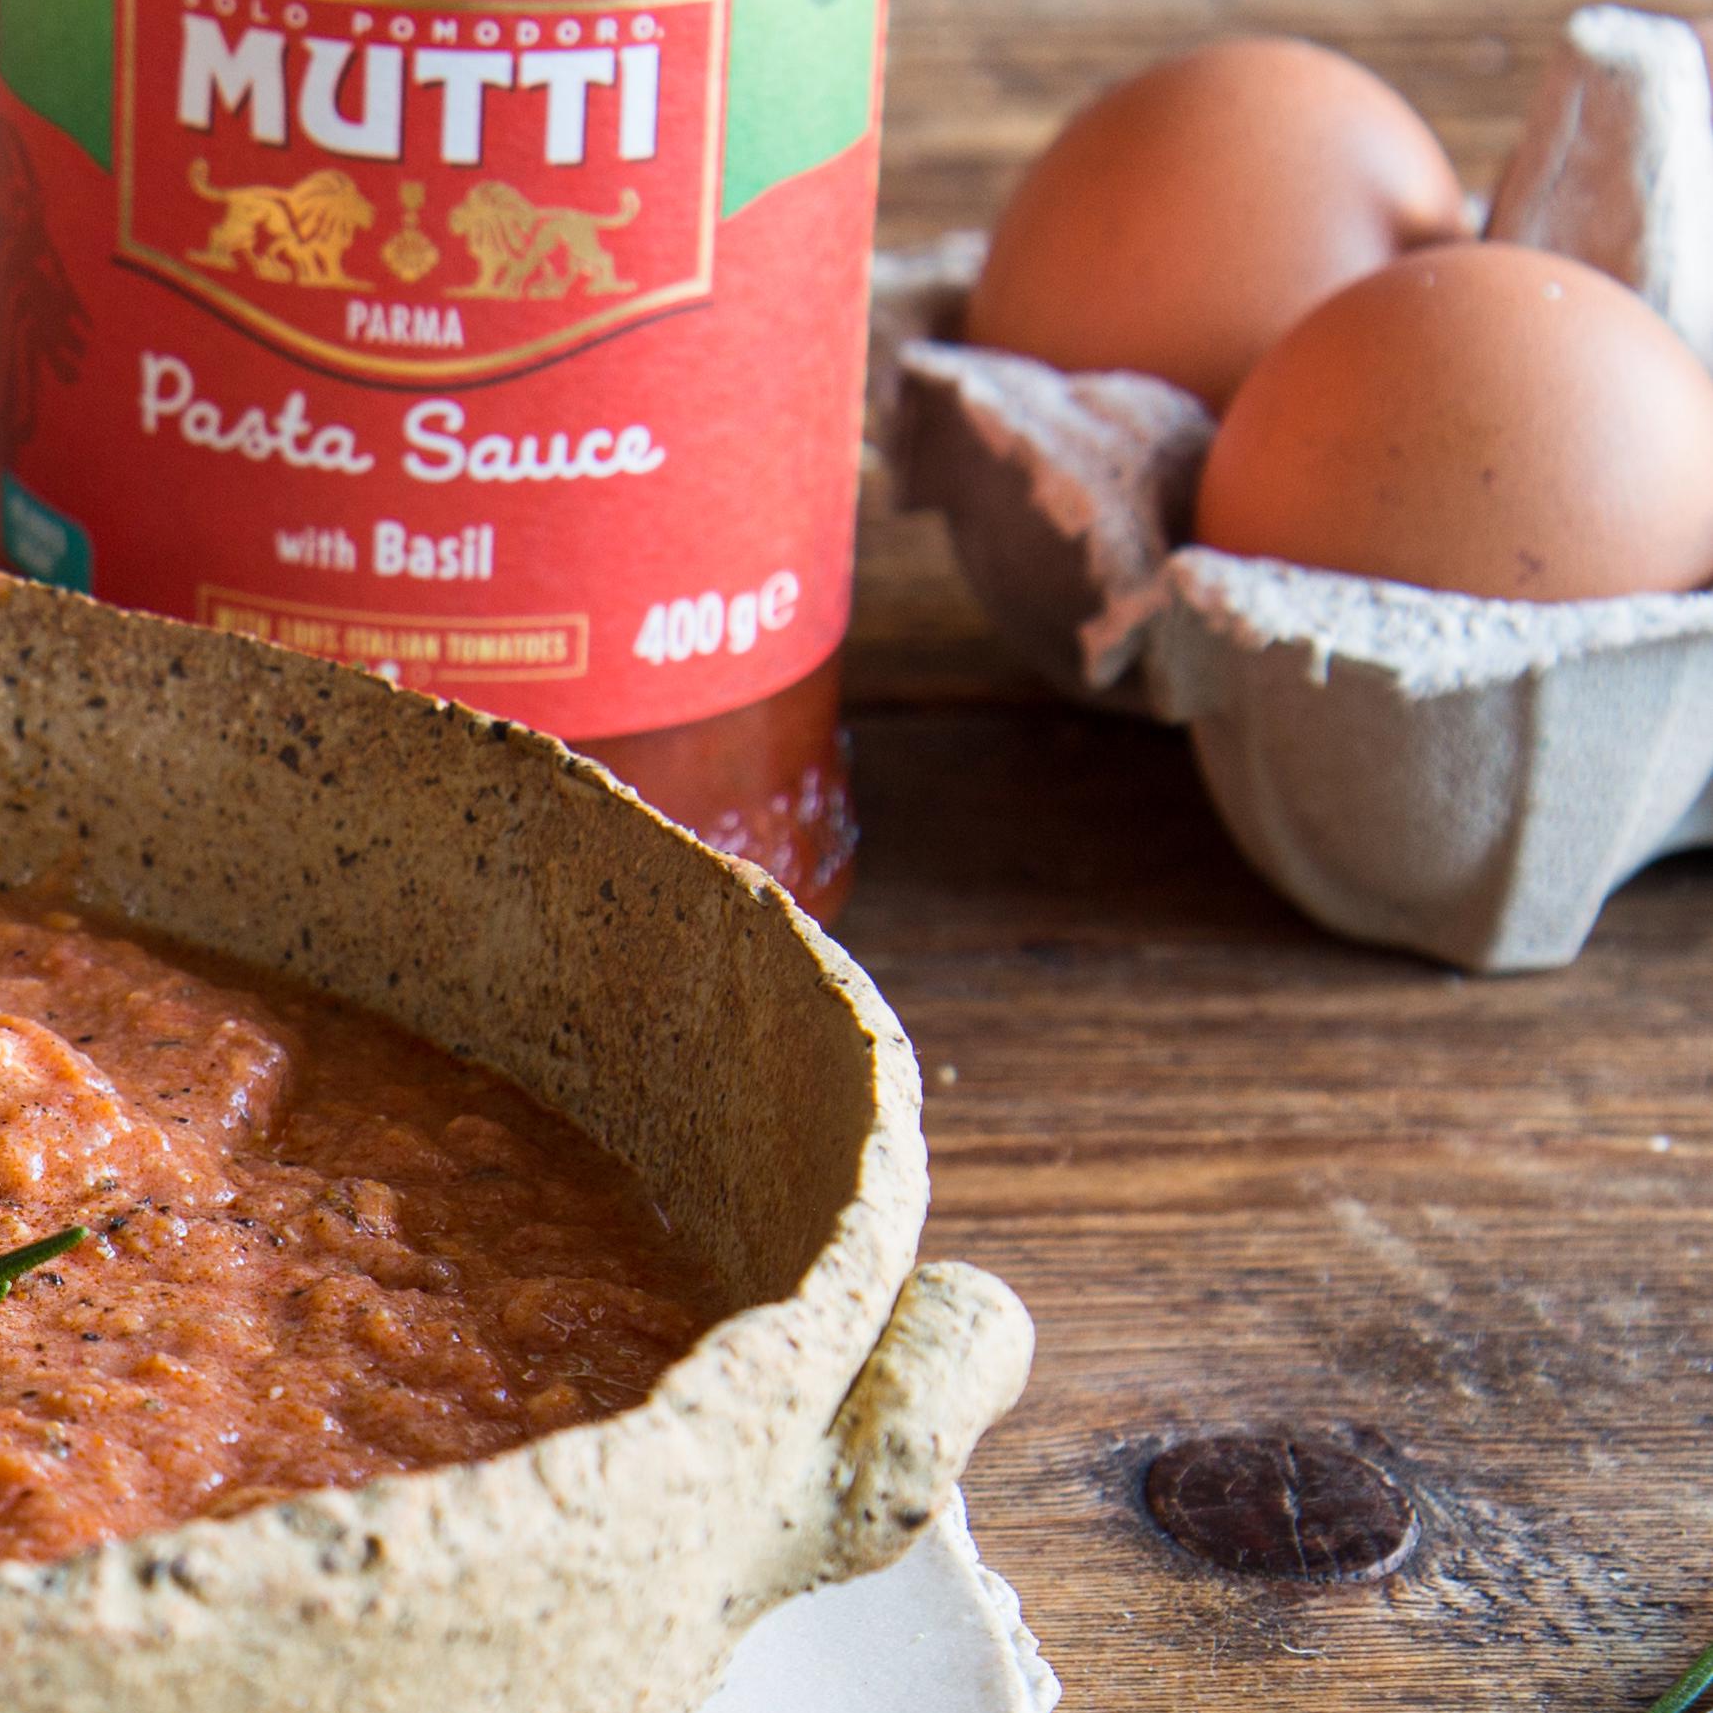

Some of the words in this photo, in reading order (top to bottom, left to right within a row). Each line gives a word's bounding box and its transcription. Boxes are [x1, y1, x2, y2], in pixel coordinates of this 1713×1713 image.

[178, 13, 660, 164] MUTTI
[346, 298, 465, 349] PARMA
[140, 351, 375, 476] Pasta
[402, 399, 667, 484] Sauce
[276, 527, 357, 573] with
[374, 520, 495, 581] Basil
